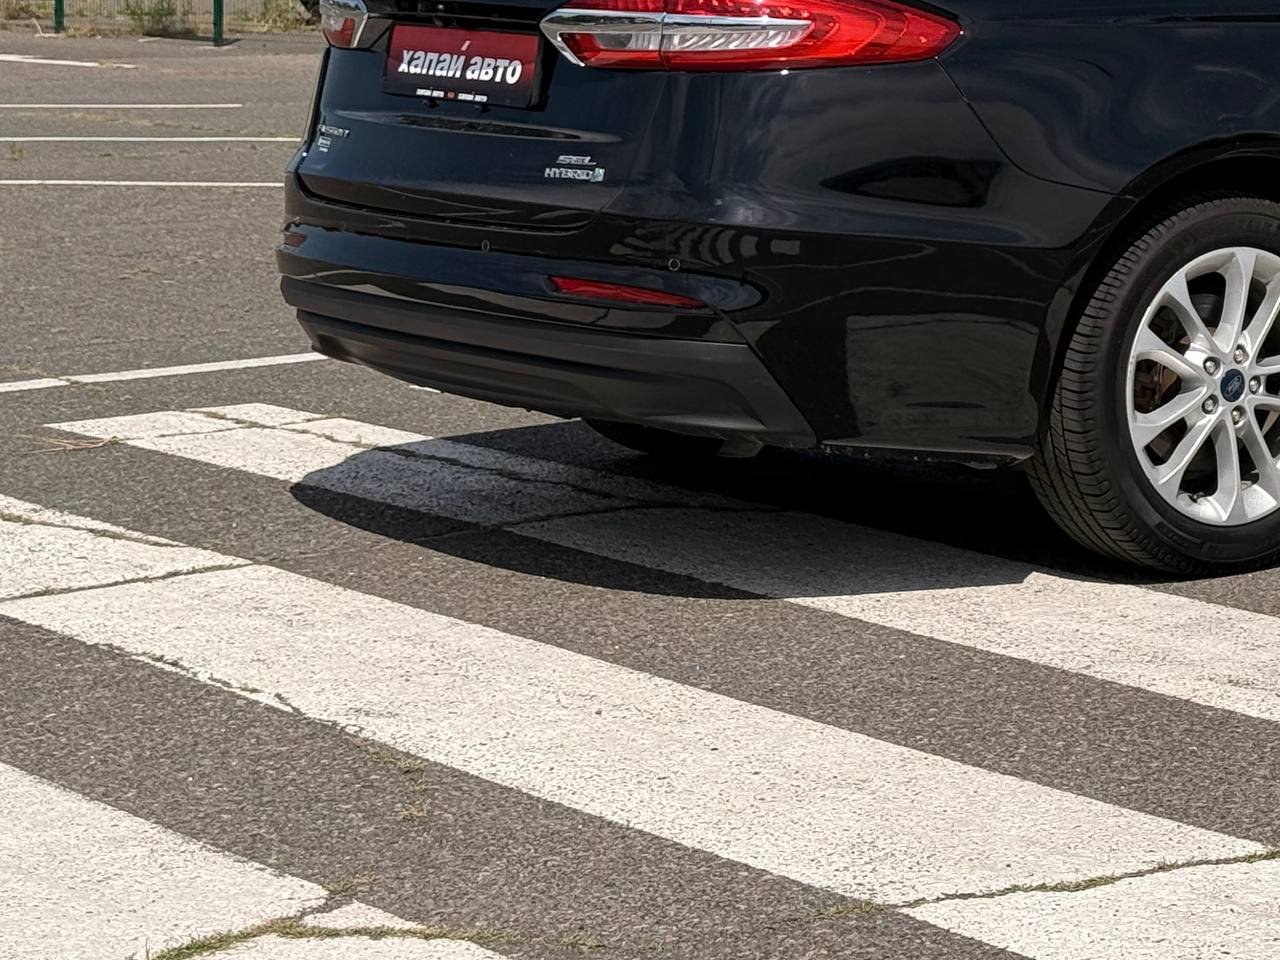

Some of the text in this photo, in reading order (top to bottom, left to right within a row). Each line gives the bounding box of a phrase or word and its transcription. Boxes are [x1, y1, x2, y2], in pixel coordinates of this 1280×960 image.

[398, 40, 523, 85] хапай авто
[544, 167, 593, 180] HYBRID
